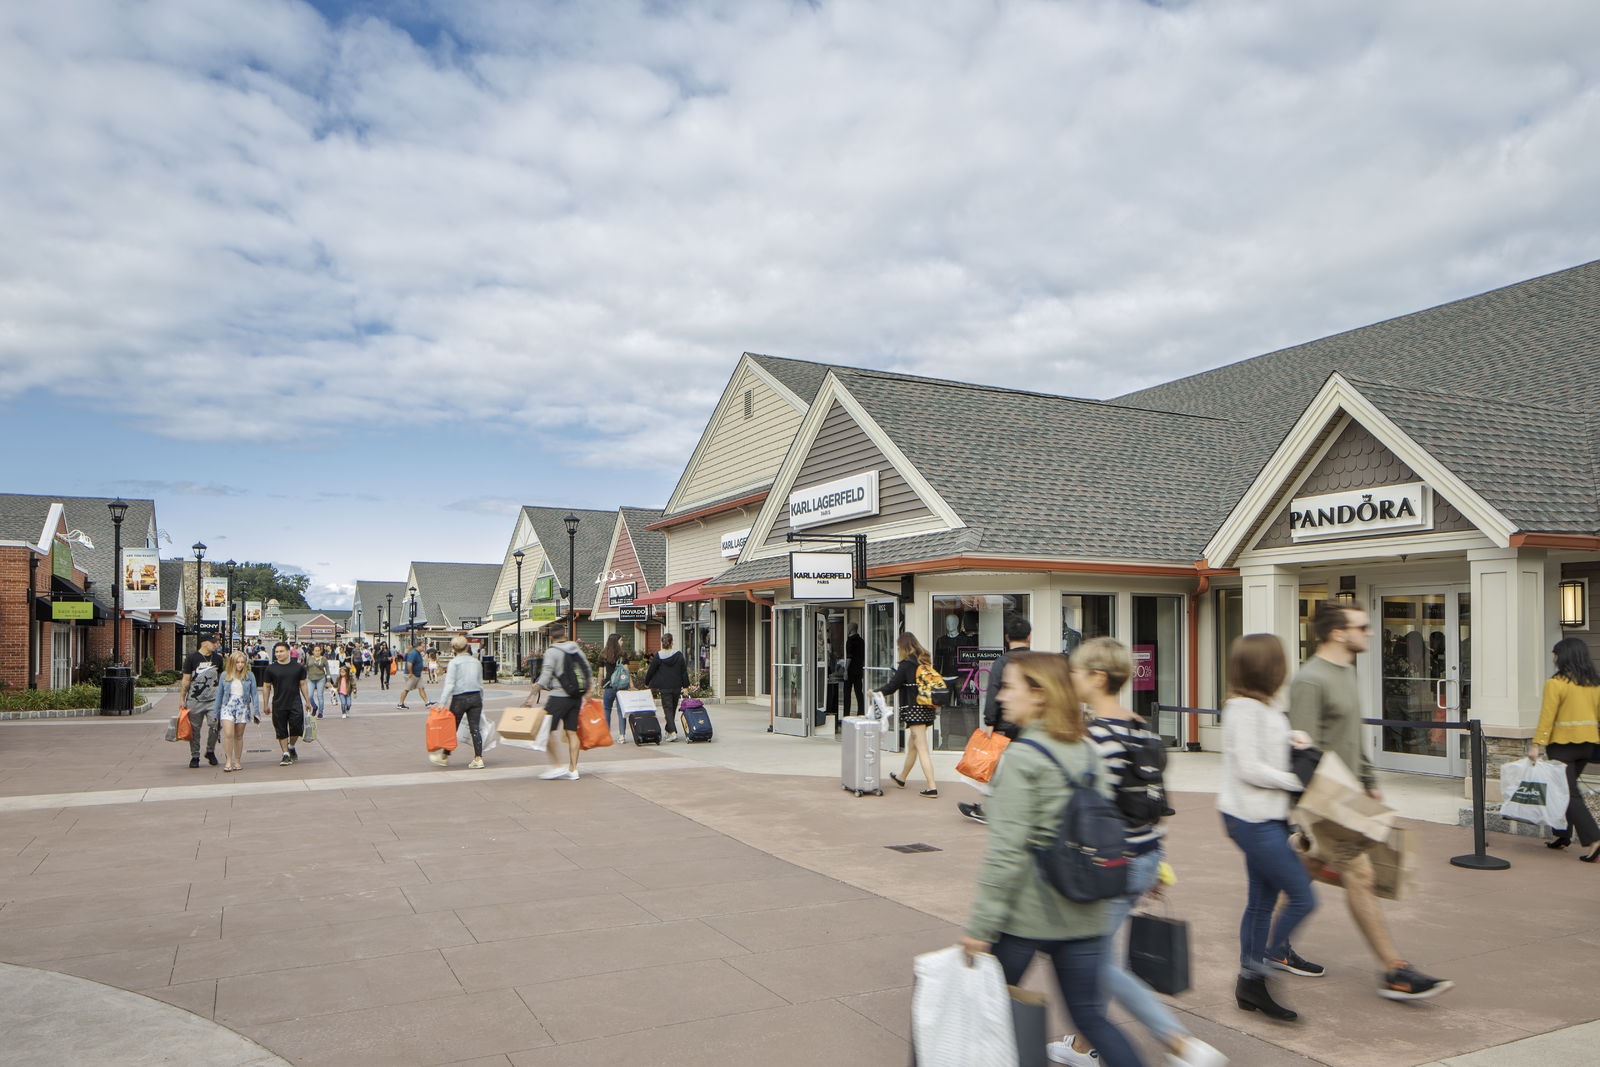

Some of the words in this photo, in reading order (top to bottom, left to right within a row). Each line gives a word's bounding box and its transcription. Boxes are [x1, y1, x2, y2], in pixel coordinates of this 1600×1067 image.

[790, 499, 812, 517] KARL
[812, 486, 865, 512] LAGERFELD
[820, 509, 831, 517] PARIS
[1290, 494, 1416, 529] PANDORA
[721, 539, 734, 551] KARL
[793, 572, 812, 580] KARL
[812, 572, 852, 580] LAGERFELD
